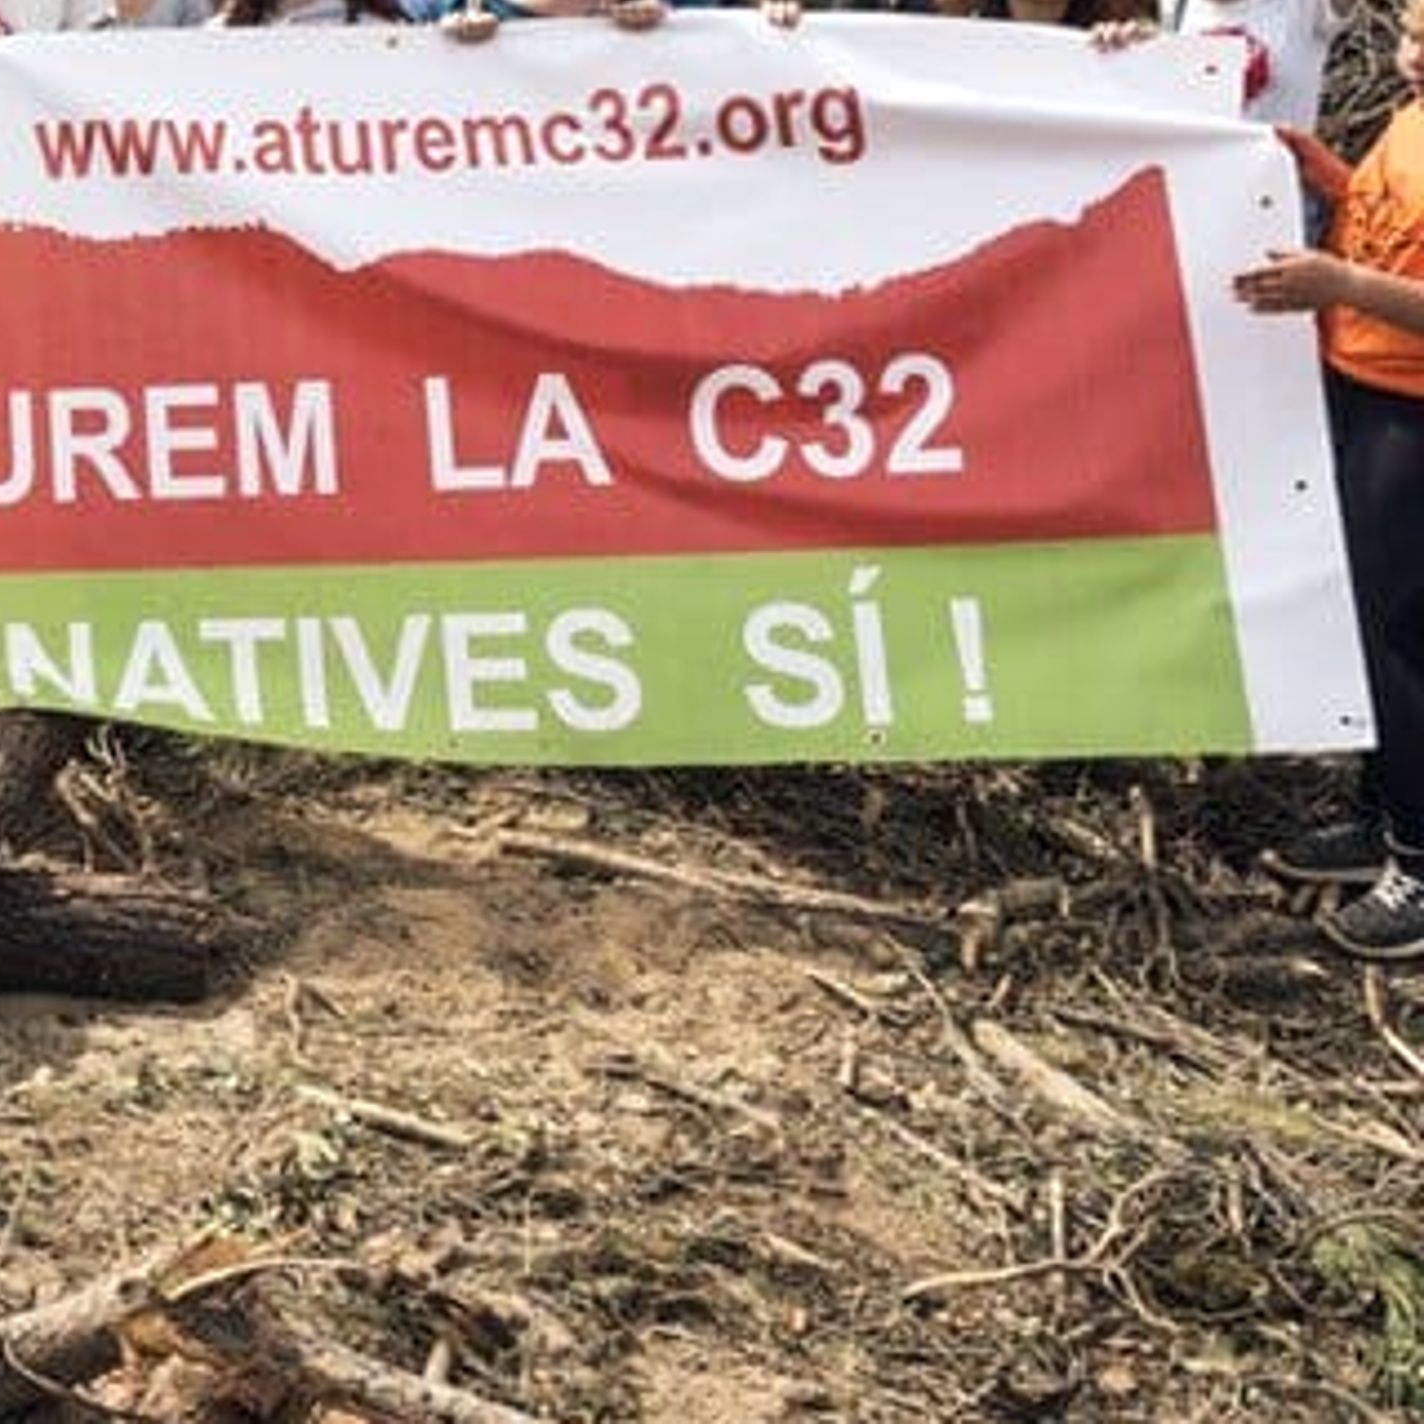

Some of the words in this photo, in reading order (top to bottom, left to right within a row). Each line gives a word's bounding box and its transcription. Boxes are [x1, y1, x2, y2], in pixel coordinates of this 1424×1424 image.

[35, 84, 868, 178] www.aturemc32.org
[424, 373, 613, 492] LA
[689, 354, 965, 482] C32
[740, 565, 895, 731] SÍ
[949, 594, 995, 726] !
